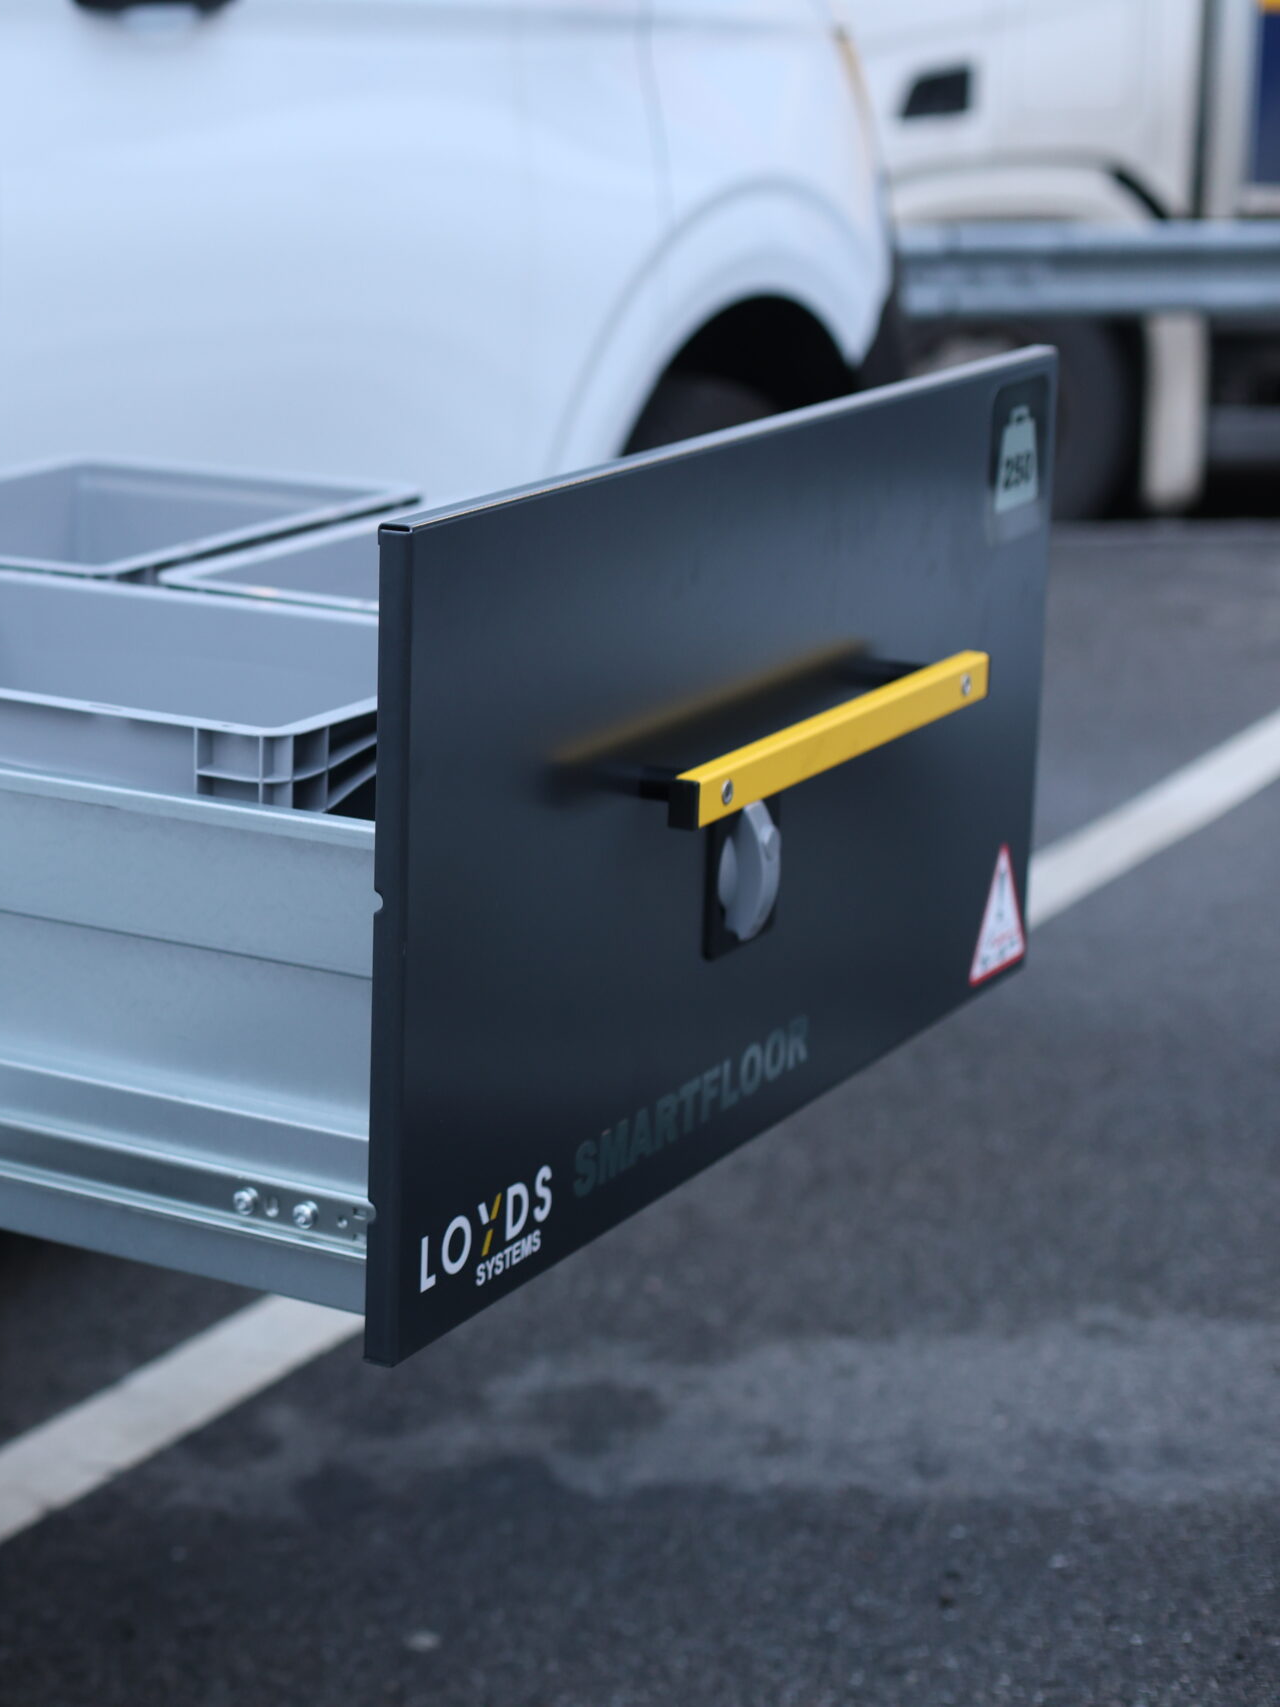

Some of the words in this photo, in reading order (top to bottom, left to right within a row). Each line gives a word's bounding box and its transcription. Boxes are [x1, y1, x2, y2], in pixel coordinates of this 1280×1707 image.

[573, 1014, 810, 1198] SMARTFLOOR
[420, 1165, 552, 1293] LOYDS
[475, 1230, 541, 1286] SYSTEMS
